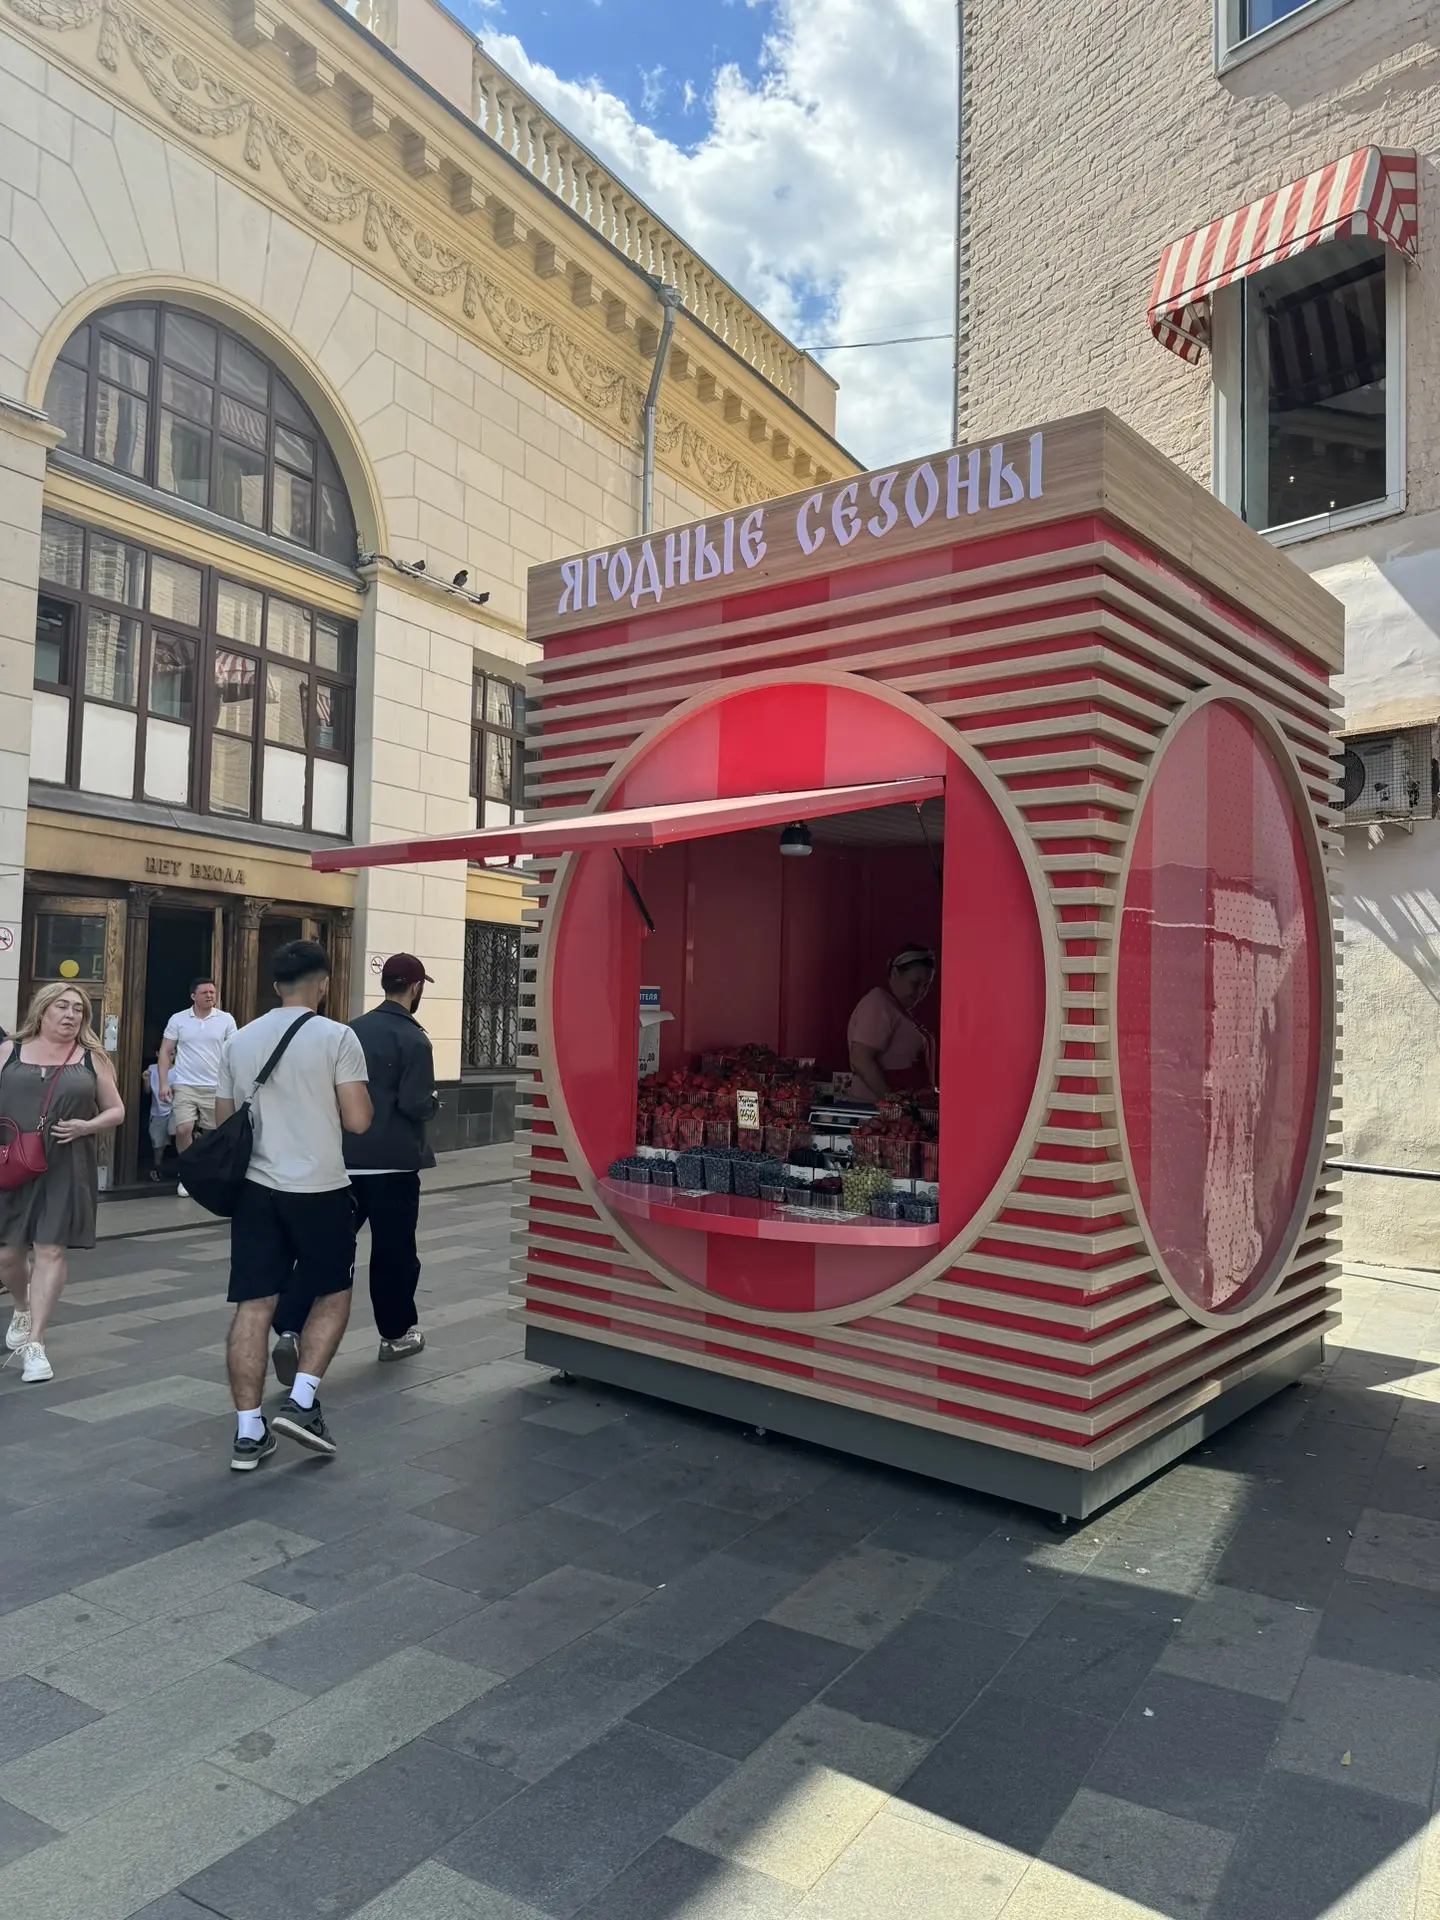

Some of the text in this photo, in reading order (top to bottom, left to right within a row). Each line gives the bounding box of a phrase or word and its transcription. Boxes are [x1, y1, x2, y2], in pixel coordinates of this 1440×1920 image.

[558, 432, 1043, 615] ЯГОДНЫЕ СЕЗОНЫ
[145, 857, 246, 885] НЕТ ВХОДА
